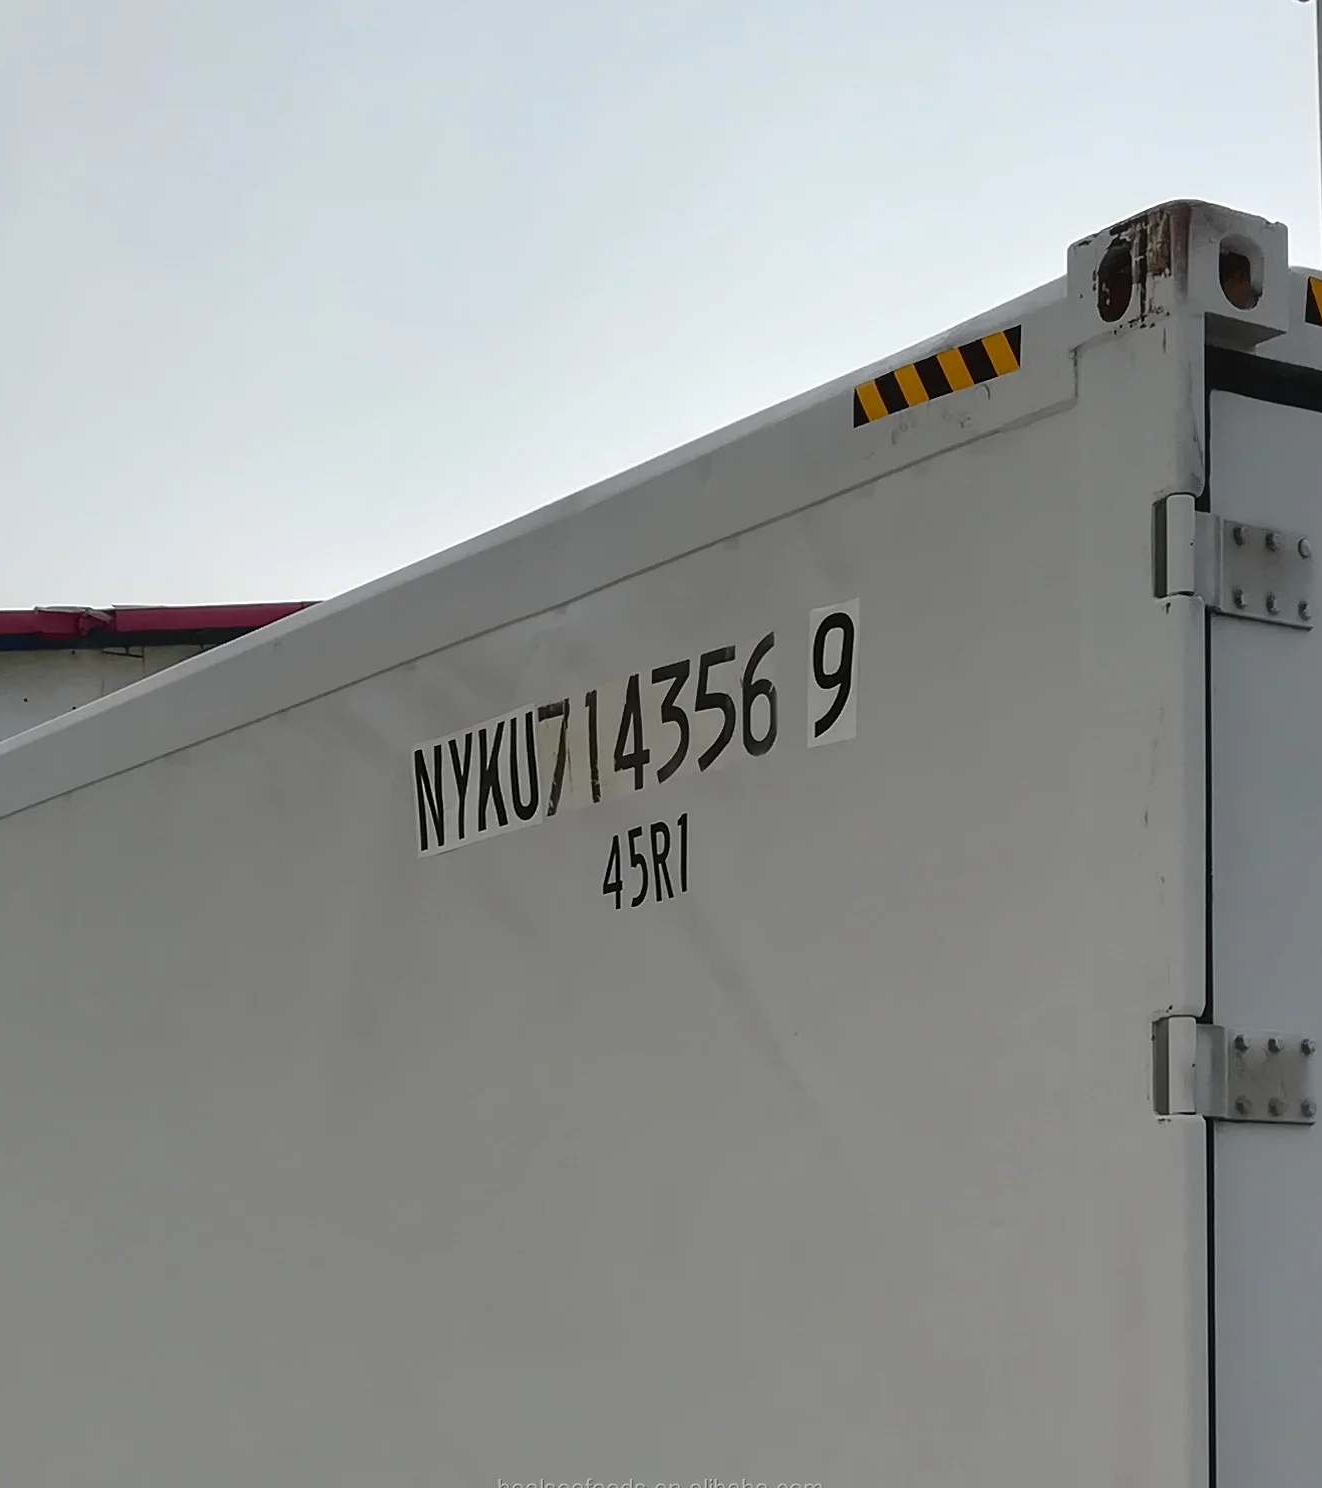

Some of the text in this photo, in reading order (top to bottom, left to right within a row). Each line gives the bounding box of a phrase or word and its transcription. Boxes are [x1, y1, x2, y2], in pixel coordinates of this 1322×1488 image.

[414, 612, 855, 851] NYKU714356 9
[602, 812, 689, 910] 45R1
